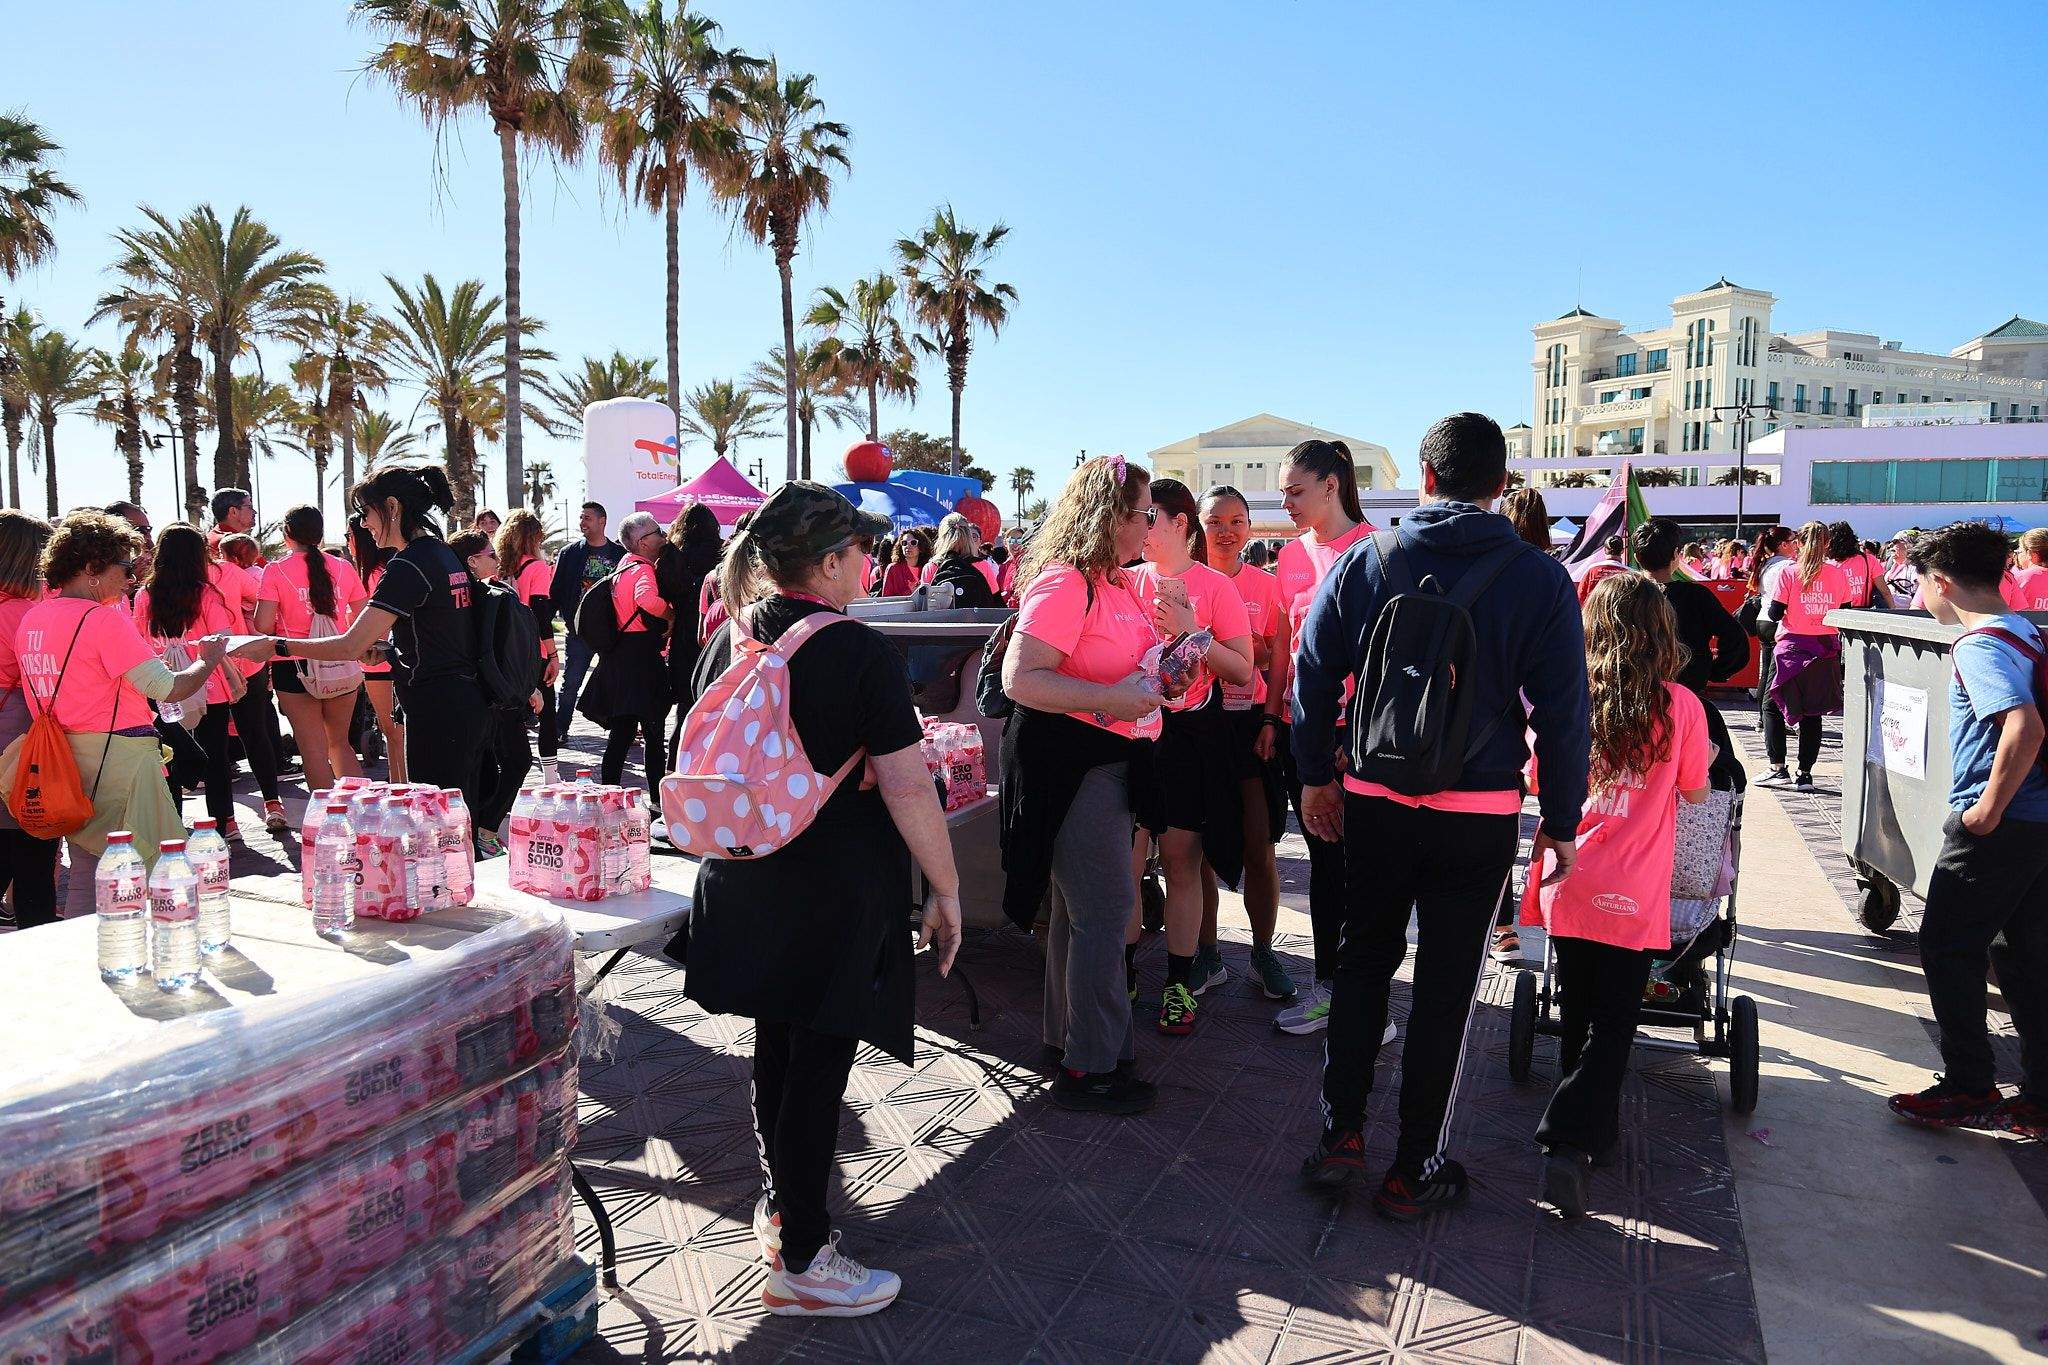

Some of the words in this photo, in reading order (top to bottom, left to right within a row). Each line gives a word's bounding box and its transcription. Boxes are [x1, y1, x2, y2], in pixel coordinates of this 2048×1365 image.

[636, 471, 677, 483] TotalEnerg
[1801, 592, 1836, 604] DORSAL
[1805, 603, 1829, 615] SUMA
[27, 630, 44, 652] TU
[437, 840, 461, 849] SODIO
[528, 841, 563, 857] ZERO
[527, 852, 564, 869] SODIO
[204, 874, 229, 885] SODIO
[112, 893, 142, 903] SODIO
[345, 1054, 401, 1091] ZERO
[344, 1071, 404, 1107] SODIO
[180, 1113, 251, 1151] ZERO
[180, 1136, 252, 1174] SODIO
[347, 1200, 405, 1239] SODIO
[188, 1267, 257, 1318] ZERO
[187, 1287, 259, 1337] SODIO
